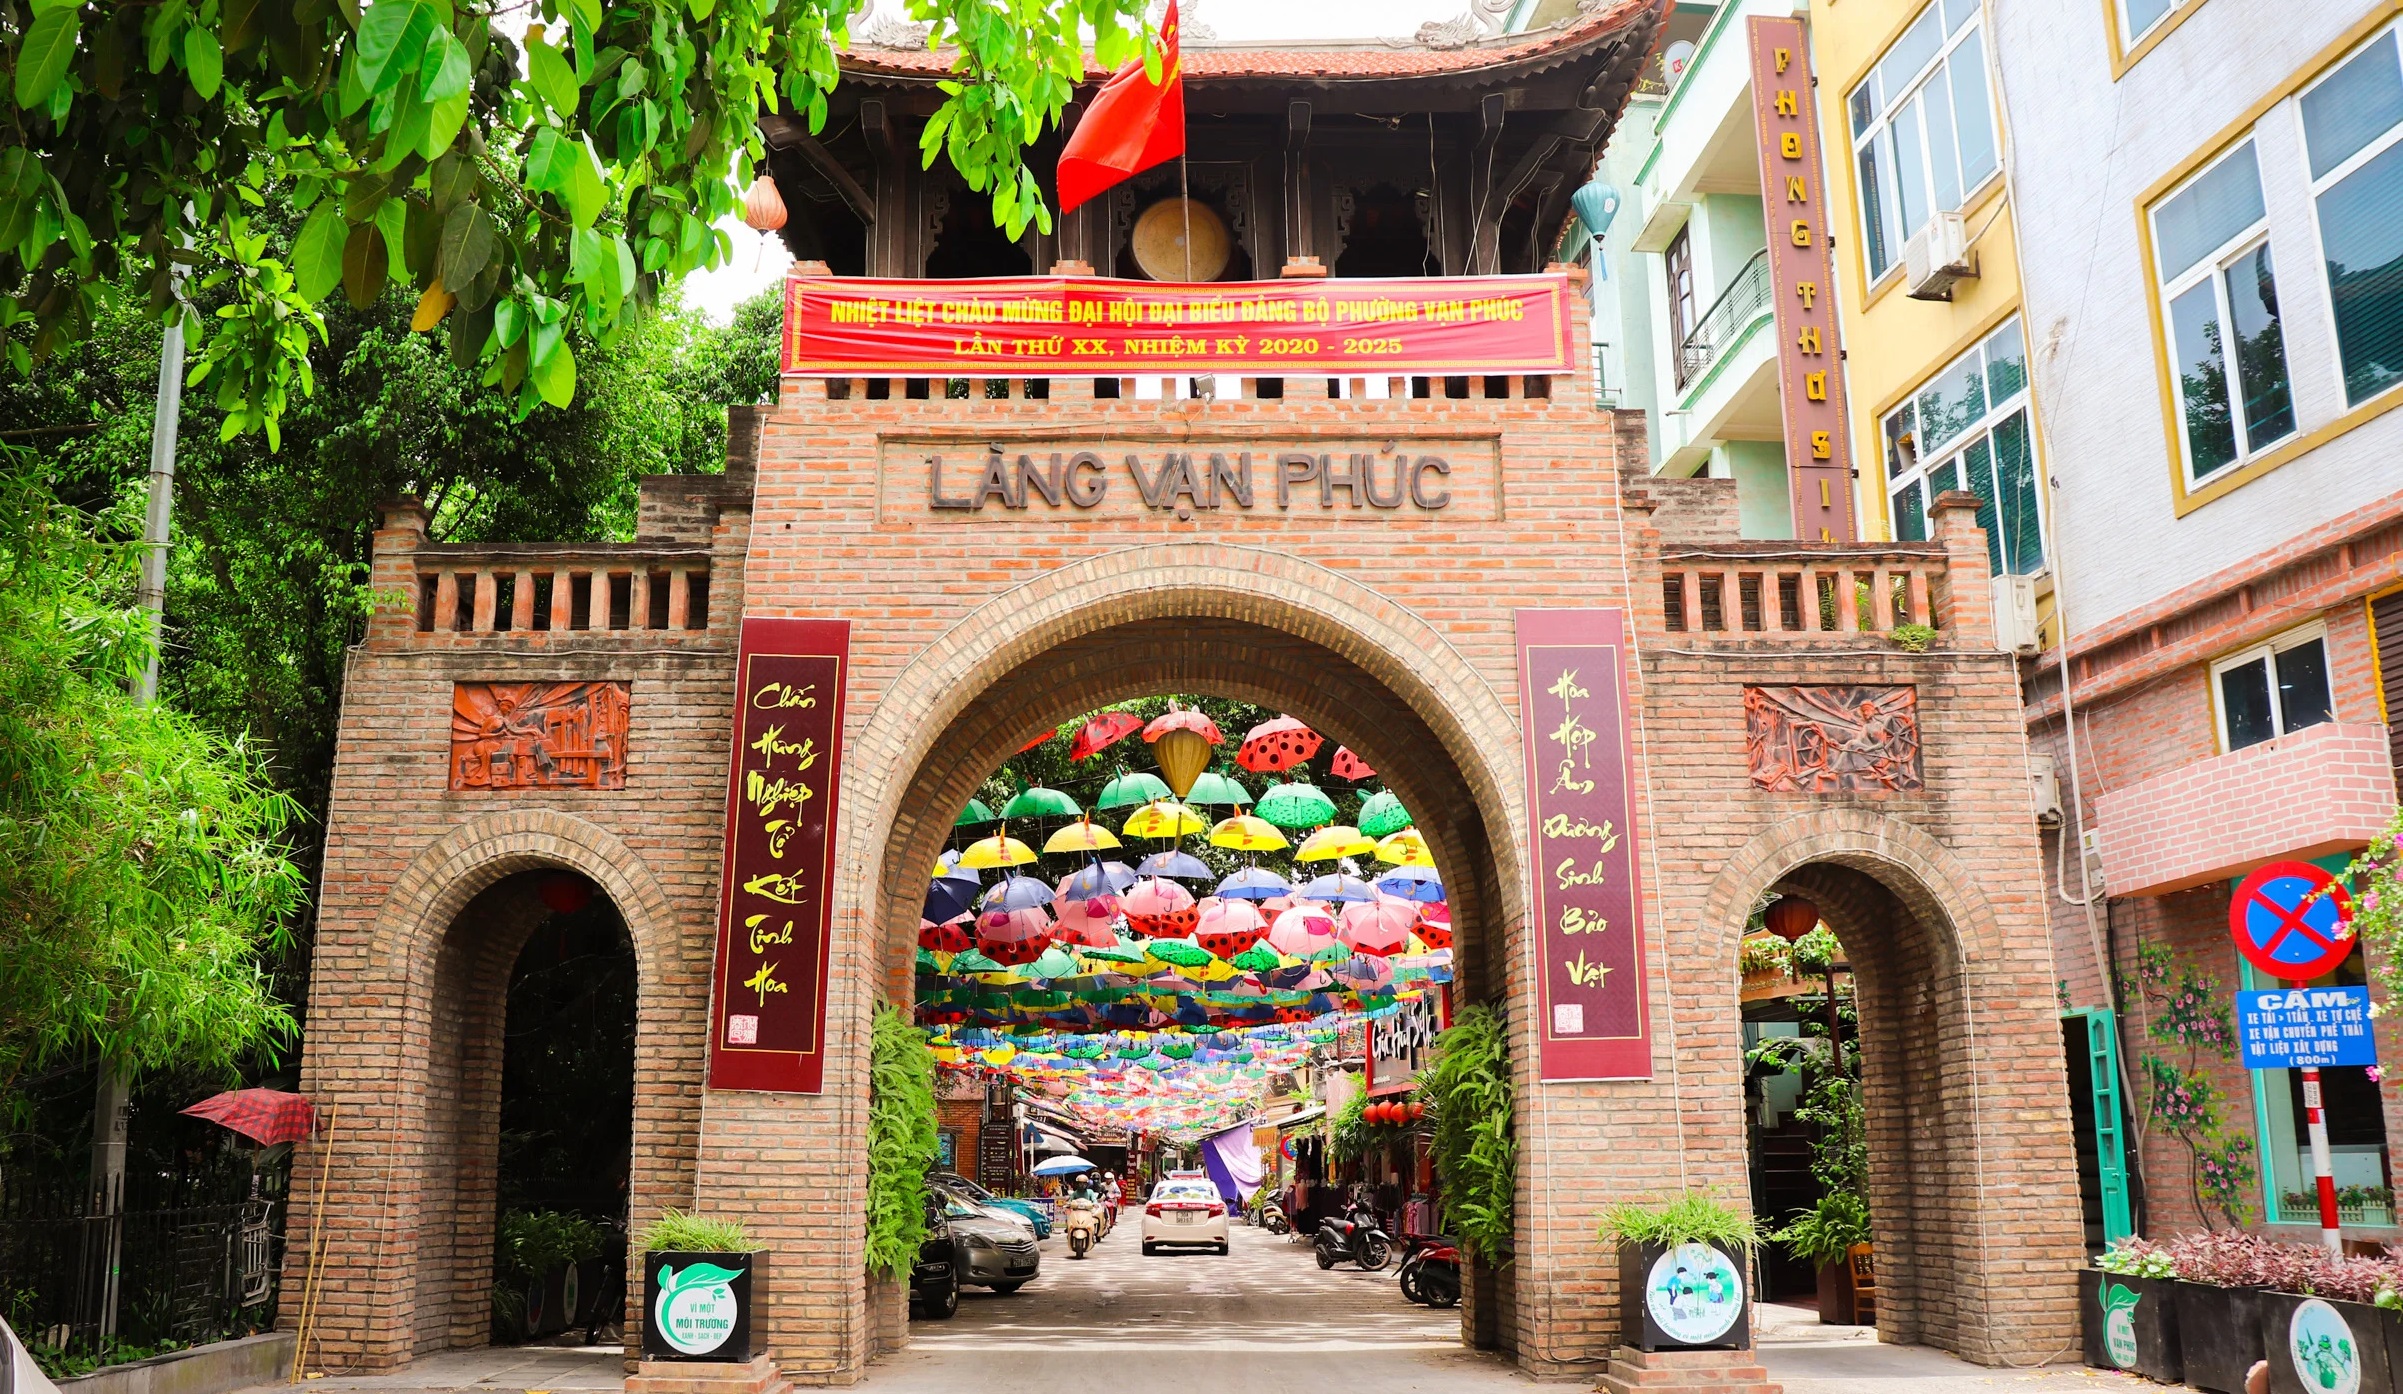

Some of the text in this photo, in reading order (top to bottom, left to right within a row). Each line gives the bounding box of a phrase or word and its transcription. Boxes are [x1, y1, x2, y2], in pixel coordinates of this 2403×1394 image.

[830, 294, 1524, 328] NHIỆT LIỆT CHÀO MỪNG ĐẠI HỘI ĐẠI BIỂU ĐẢNG BỘ PHƯỜNG VẠN PHÚC
[953, 330, 1004, 355] LẦN
[1011, 334, 1065, 355] THỨ
[1071, 338, 1115, 357] XX,
[1123, 334, 1207, 358] NHIỆM
[1215, 334, 1251, 354] KỲ
[1259, 337, 1319, 355] 2020
[1343, 337, 1403, 355] 2025
[930, 438, 1451, 522] LÀNG VẠN PHÚC
[753, 682, 817, 710] Chấn
[1547, 667, 1590, 713] Hoa
[751, 722, 824, 771] Hưng
[1549, 713, 1597, 769] Hợp
[1549, 758, 1596, 796] Âm
[746, 769, 814, 828] Nghiệp
[764, 819, 796, 859] Tổ
[743, 868, 809, 905] Kết
[1555, 857, 1605, 891] Sinh
[744, 913, 794, 955] Tinh
[1559, 904, 1609, 936] Bảo
[743, 959, 788, 1008] Hoa
[1565, 948, 1615, 989] Vật
[2247, 1012, 2259, 1025] XE
[2316, 1010, 2328, 1023] XE
[2257, 988, 2347, 1010] CẤM
[2248, 1027, 2260, 1040] XE
[2263, 1025, 2280, 1041] VẬN
[2251, 1041, 2266, 1057] VẬT
[2270, 1039, 2290, 1056] LIỆU
[676, 1316, 729, 1330] MÔI TRƯỜNG
